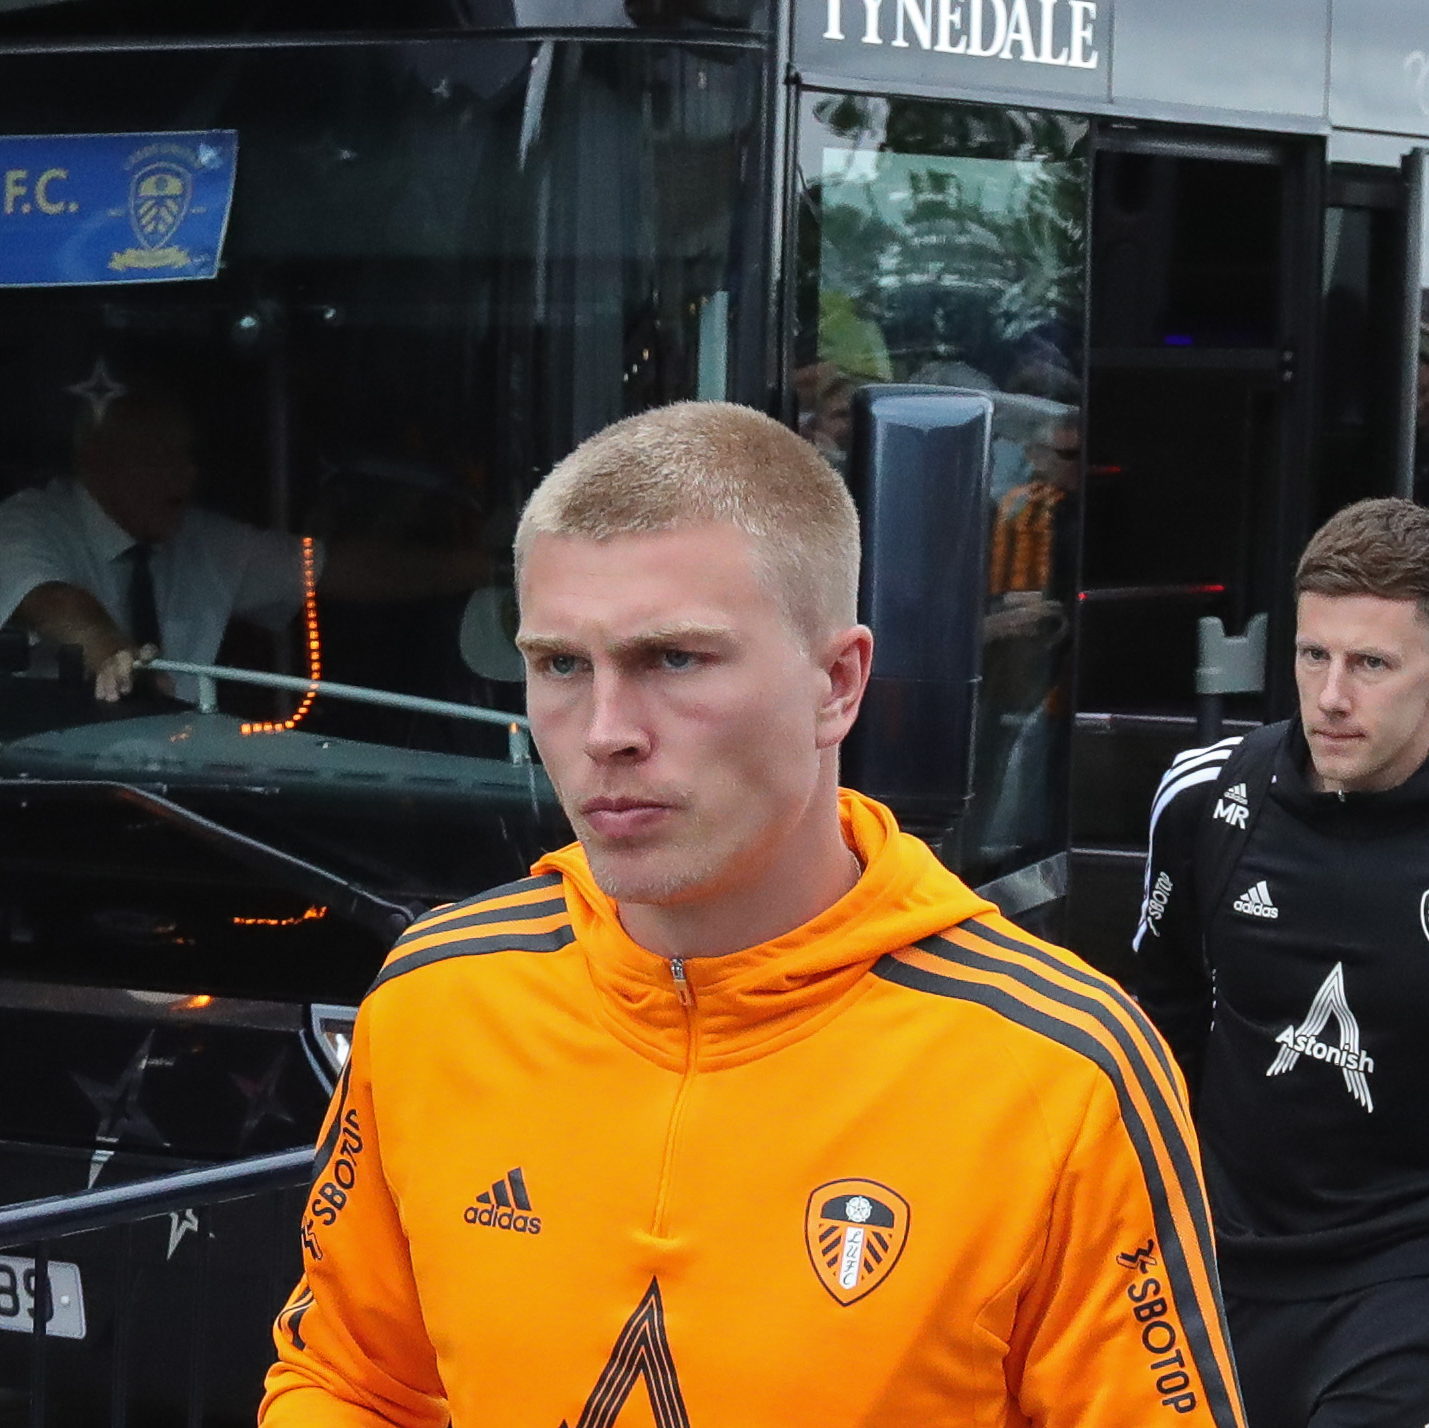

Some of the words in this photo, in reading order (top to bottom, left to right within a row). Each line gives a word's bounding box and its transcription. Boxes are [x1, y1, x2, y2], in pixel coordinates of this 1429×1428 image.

[822, 0, 1098, 69] TYNEDALE
[3, 167, 79, 215] F.C.
[1212, 798, 1250, 830] MR
[1233, 899, 1279, 919] adidas
[1275, 1024, 1374, 1074] Astonish
[463, 1203, 542, 1234] adidas
[1127, 1277, 1197, 1414] SBOTOP
